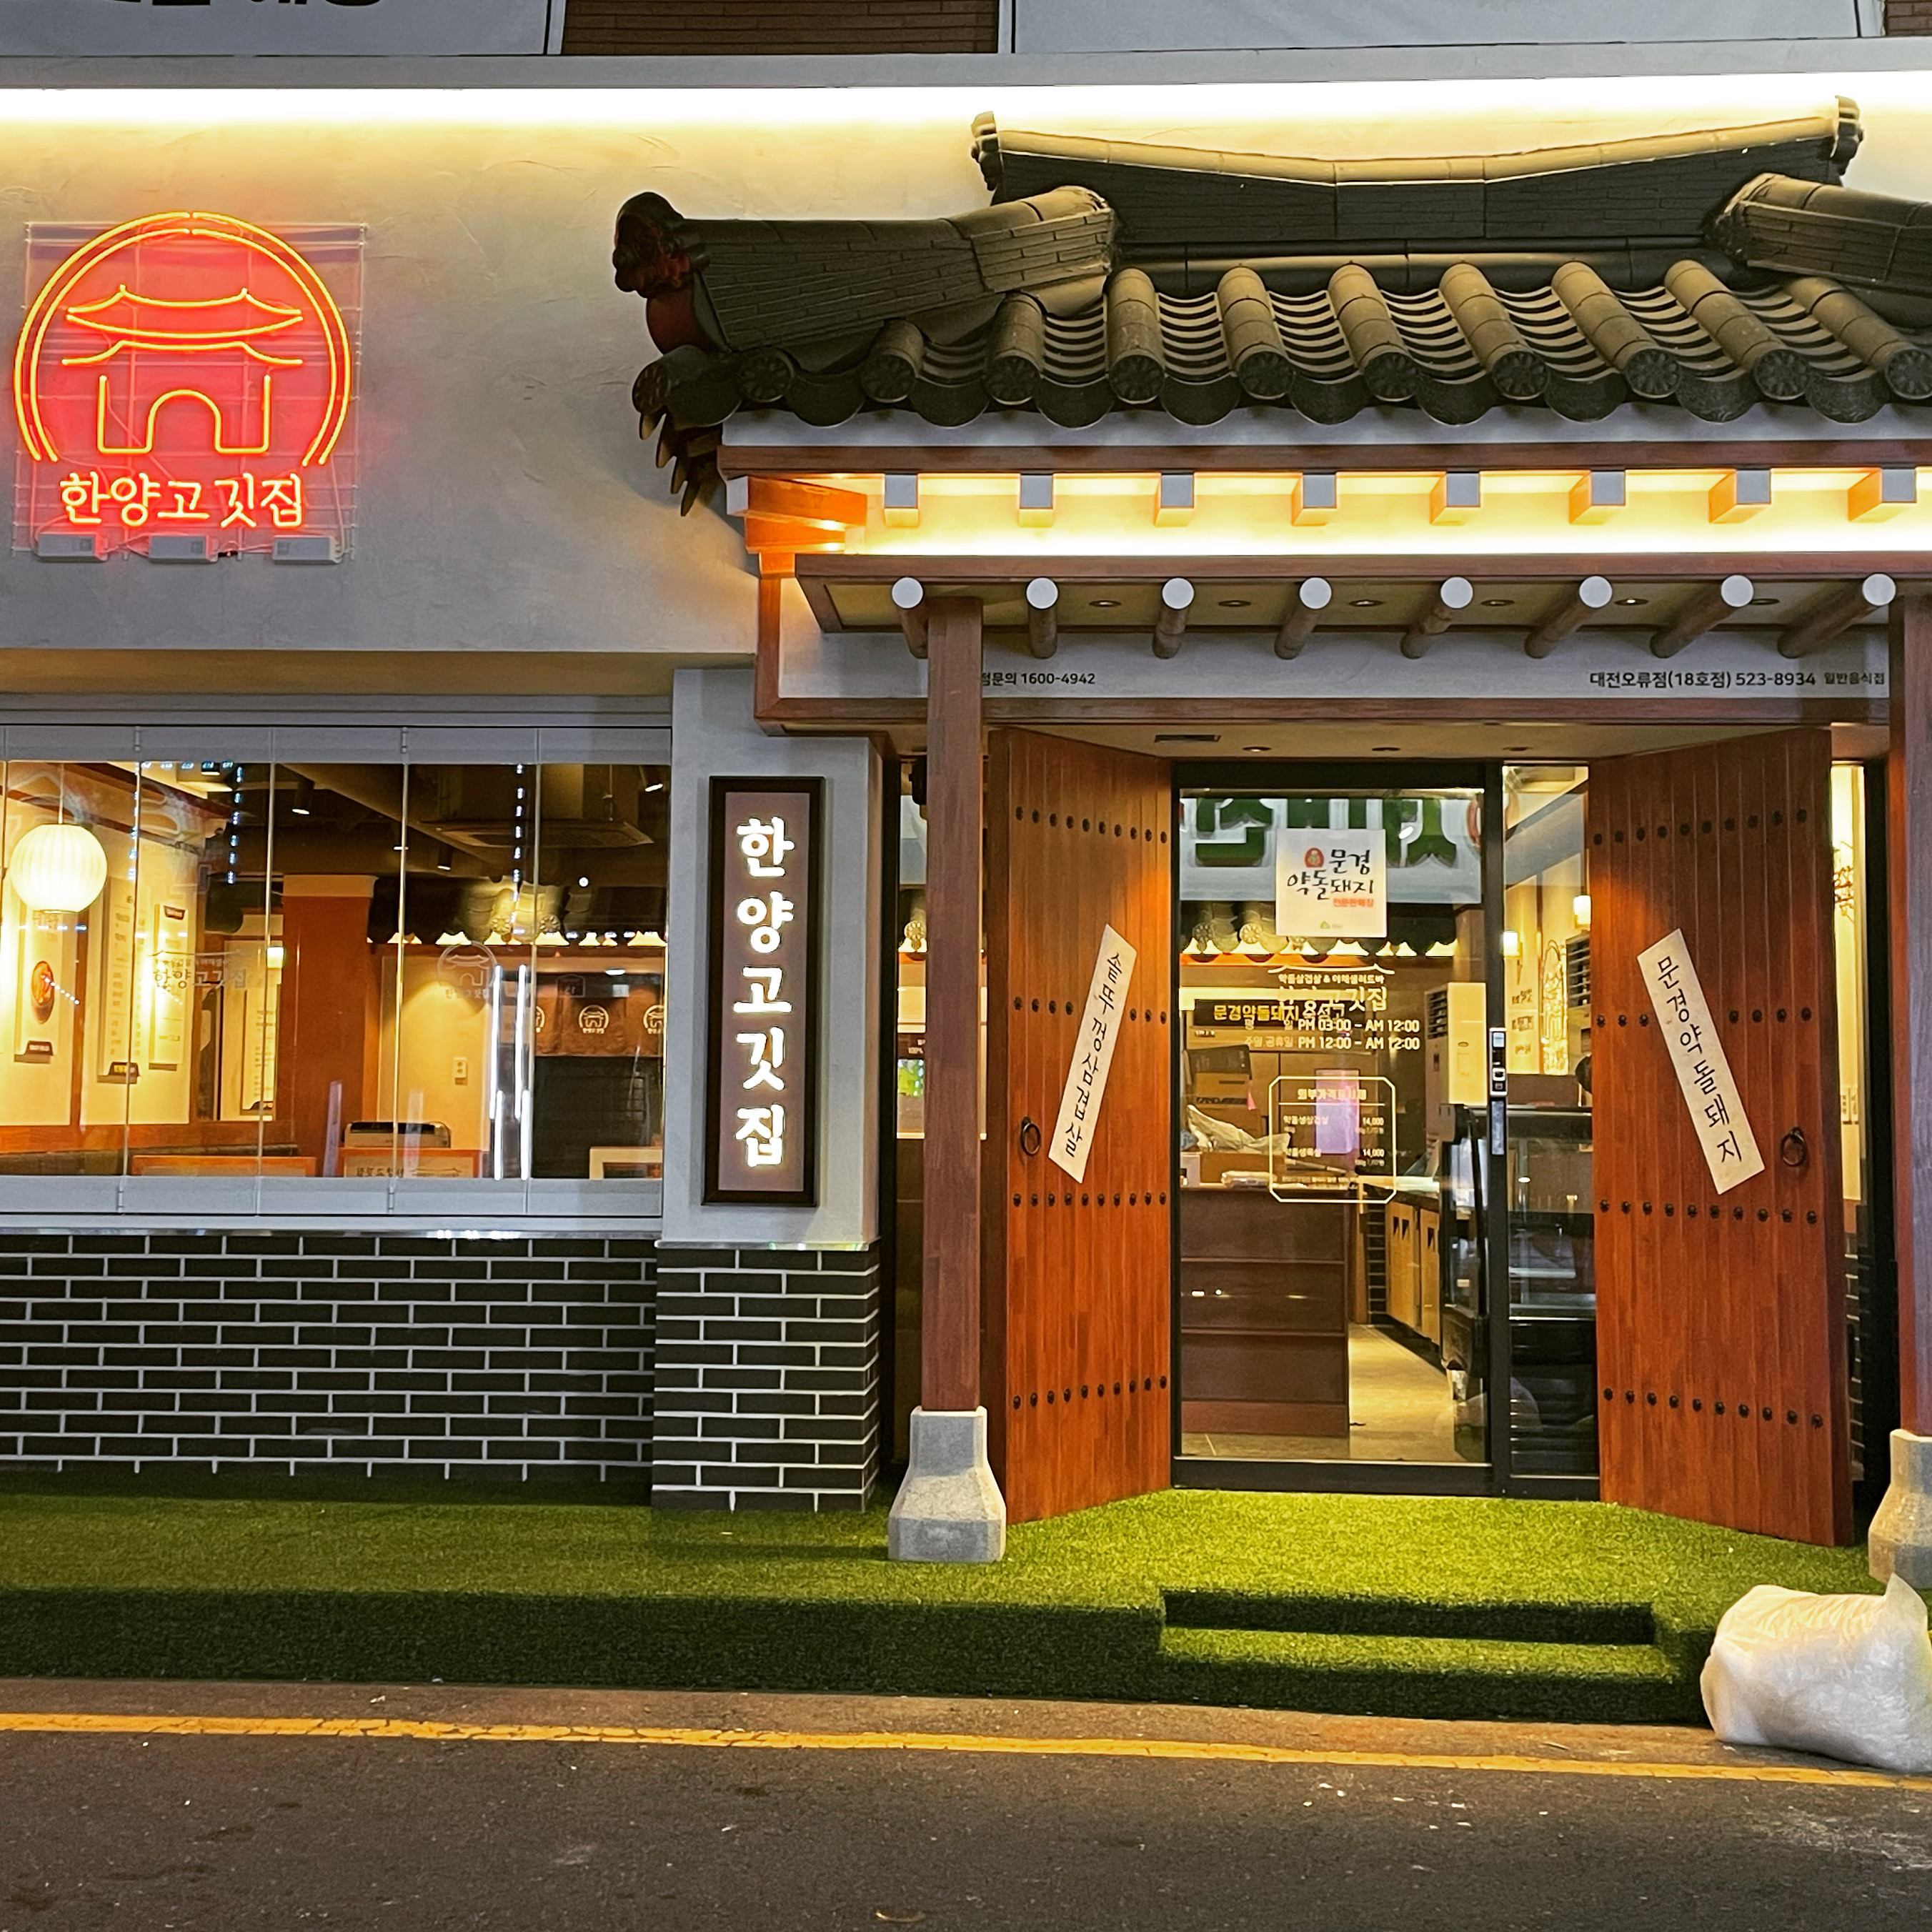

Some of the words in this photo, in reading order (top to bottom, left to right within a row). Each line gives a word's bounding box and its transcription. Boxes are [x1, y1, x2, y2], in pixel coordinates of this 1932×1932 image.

[59, 472, 304, 527] 한양고깃집
[1021, 672, 1095, 684] 1600-4942
[1589, 670, 1731, 688] 대전오류점(18호점)
[1736, 672, 1816, 687] 523-8934
[1824, 672, 1885, 684] 일반음식점
[1328, 849, 1370, 875] 문경
[1287, 870, 1374, 900] 약돌돼지
[734, 817, 795, 1167] 한양고깃집
[1298, 1020, 1313, 1031] PM
[1318, 1020, 1351, 1032] 03:00
[1365, 1020, 1384, 1032] AM
[1388, 1020, 1420, 1032] 12:00
[1298, 1037, 1314, 1049] PM
[1319, 1037, 1351, 1049] 12:00
[1365, 1037, 1384, 1050] AM
[1388, 1037, 1420, 1050] 12:00
[1657, 955, 1743, 1163] 문경약돌돼지
[1362, 1116, 1385, 1127] 14,000
[1363, 1148, 1385, 1158] 14,000
